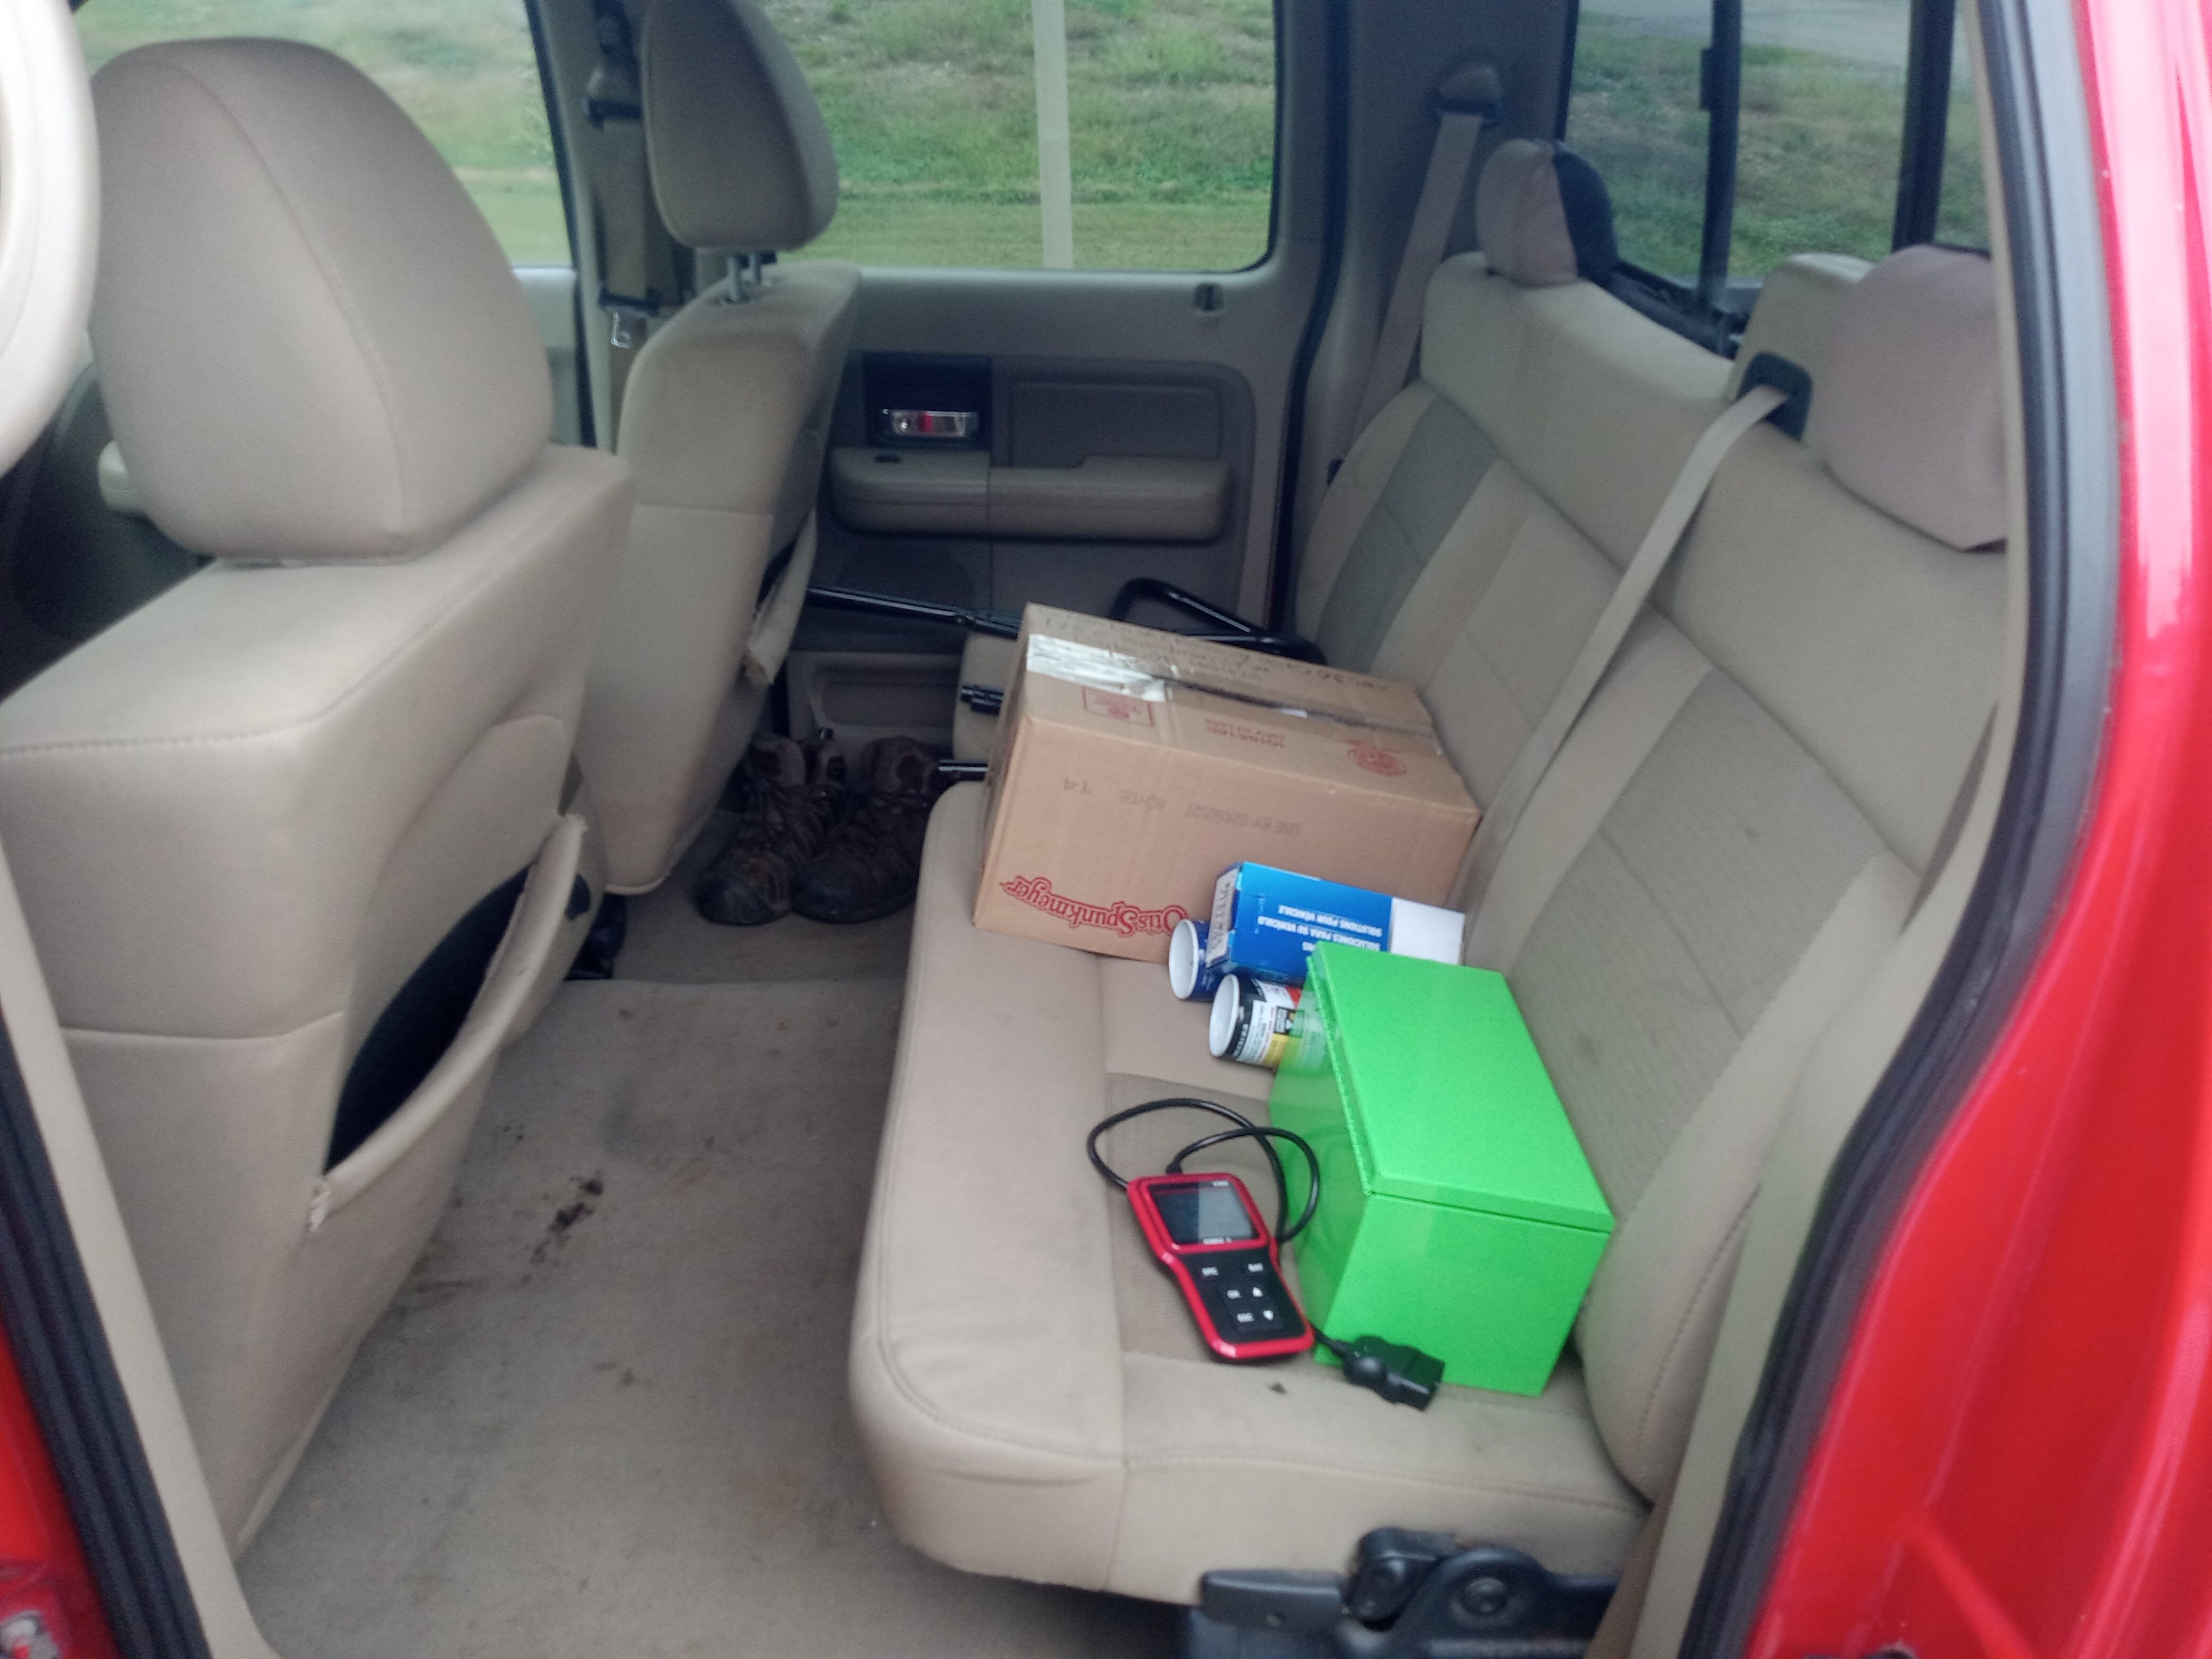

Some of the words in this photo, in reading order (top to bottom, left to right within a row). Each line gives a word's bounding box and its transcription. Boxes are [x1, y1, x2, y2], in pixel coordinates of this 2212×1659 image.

[1000, 876, 1138, 938] Spunkmeyer
[1316, 913, 1339, 927] POUR
[1297, 925, 1309, 936] SU
[1310, 928, 1331, 941] PARA
[1339, 918, 1382, 937] SOLUTIONS
